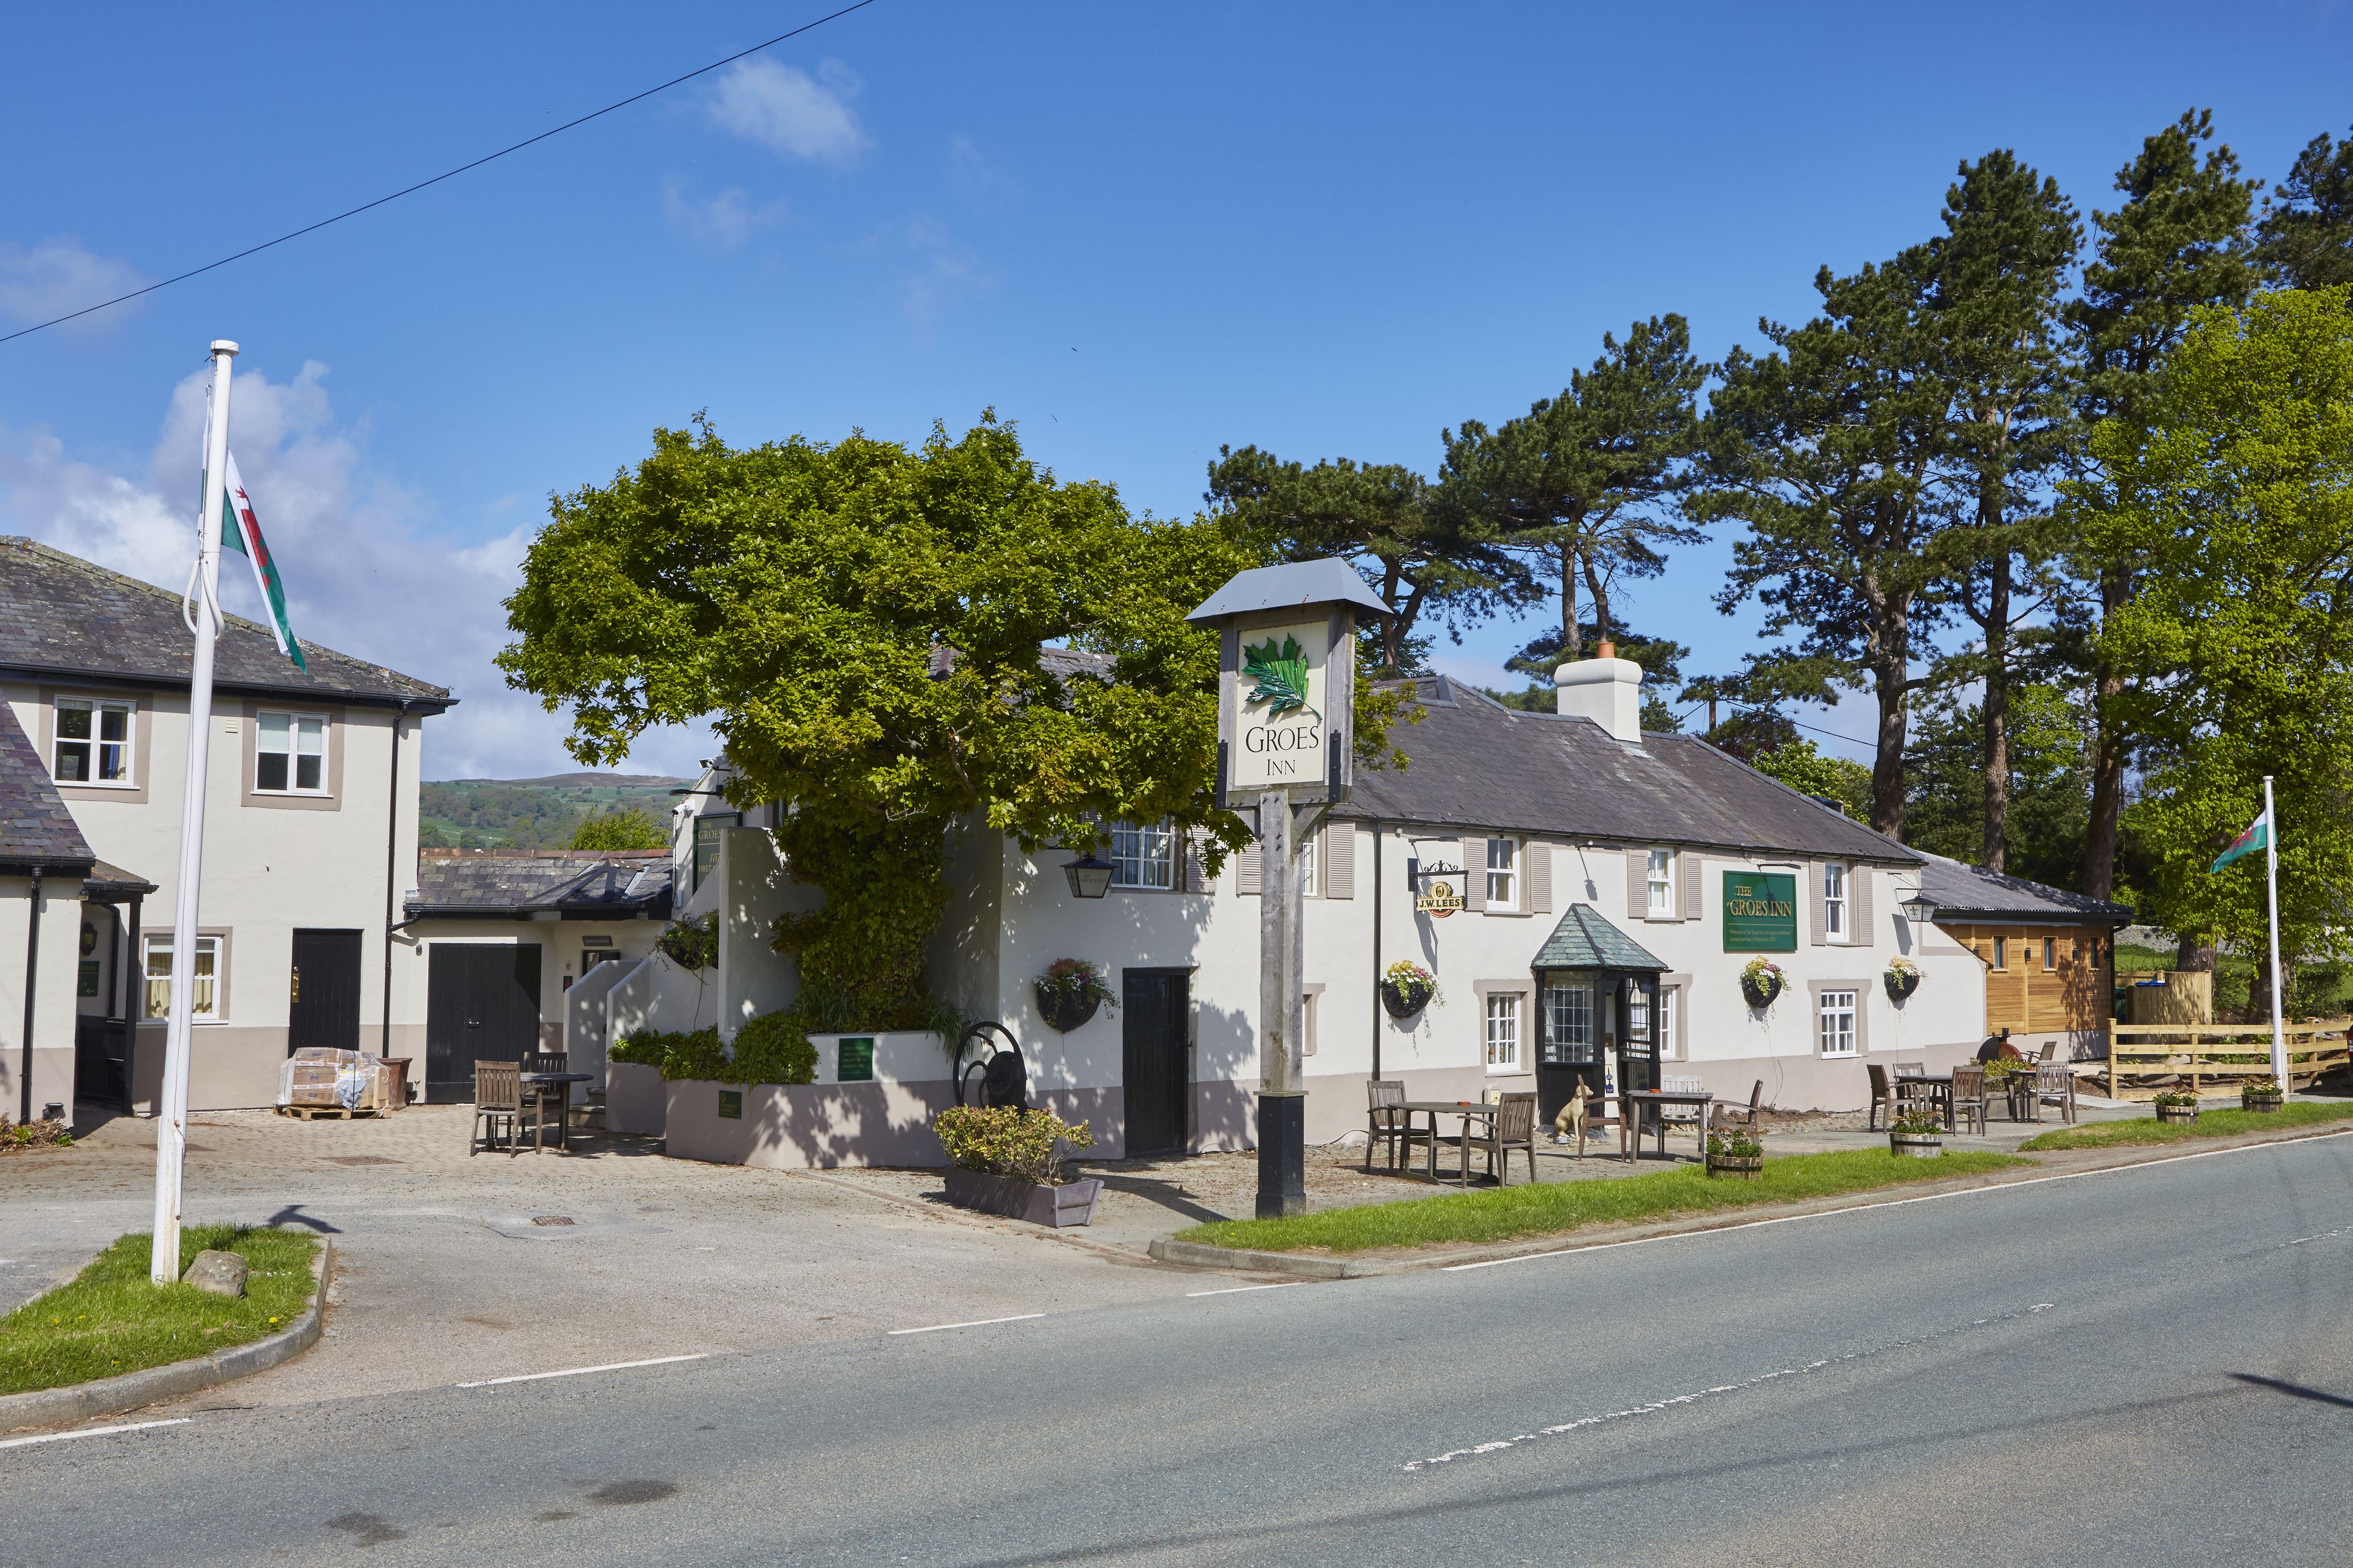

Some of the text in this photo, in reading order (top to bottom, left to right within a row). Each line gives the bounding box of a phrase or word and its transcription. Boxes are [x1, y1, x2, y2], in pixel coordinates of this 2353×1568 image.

[1245, 725, 1319, 753] GROES
[1267, 759, 1295, 776] INN
[709, 853, 721, 862] 157
[698, 865, 711, 873] FIRST
[1735, 886, 1752, 896] THE
[1730, 899, 1792, 918] GROES INN
